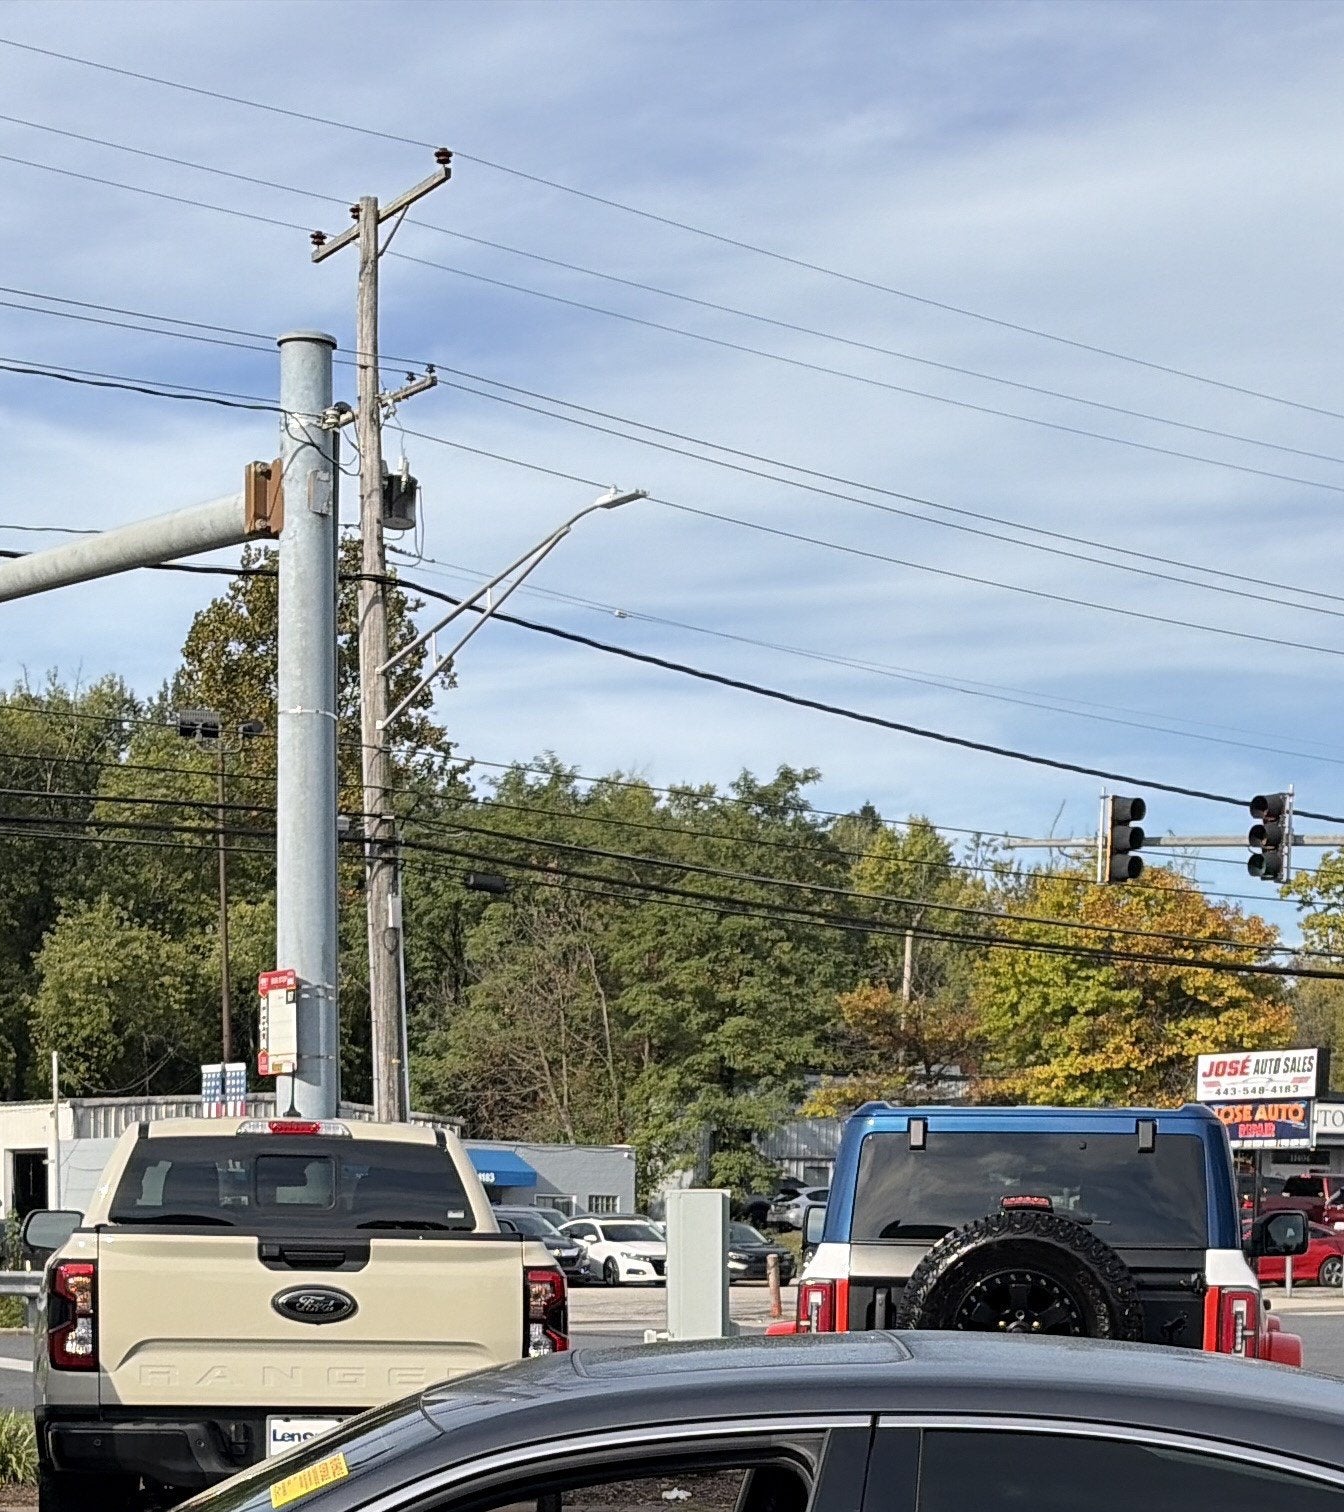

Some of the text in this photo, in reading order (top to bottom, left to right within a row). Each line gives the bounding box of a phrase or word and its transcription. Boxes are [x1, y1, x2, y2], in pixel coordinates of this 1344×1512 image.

[1201, 1055, 1315, 1078] JOSÉ AUTO SALES
[1214, 1084, 1299, 1096] 443-548-4183
[1254, 1102, 1305, 1125] AUTO
[1238, 1122, 1275, 1138] REPAIR
